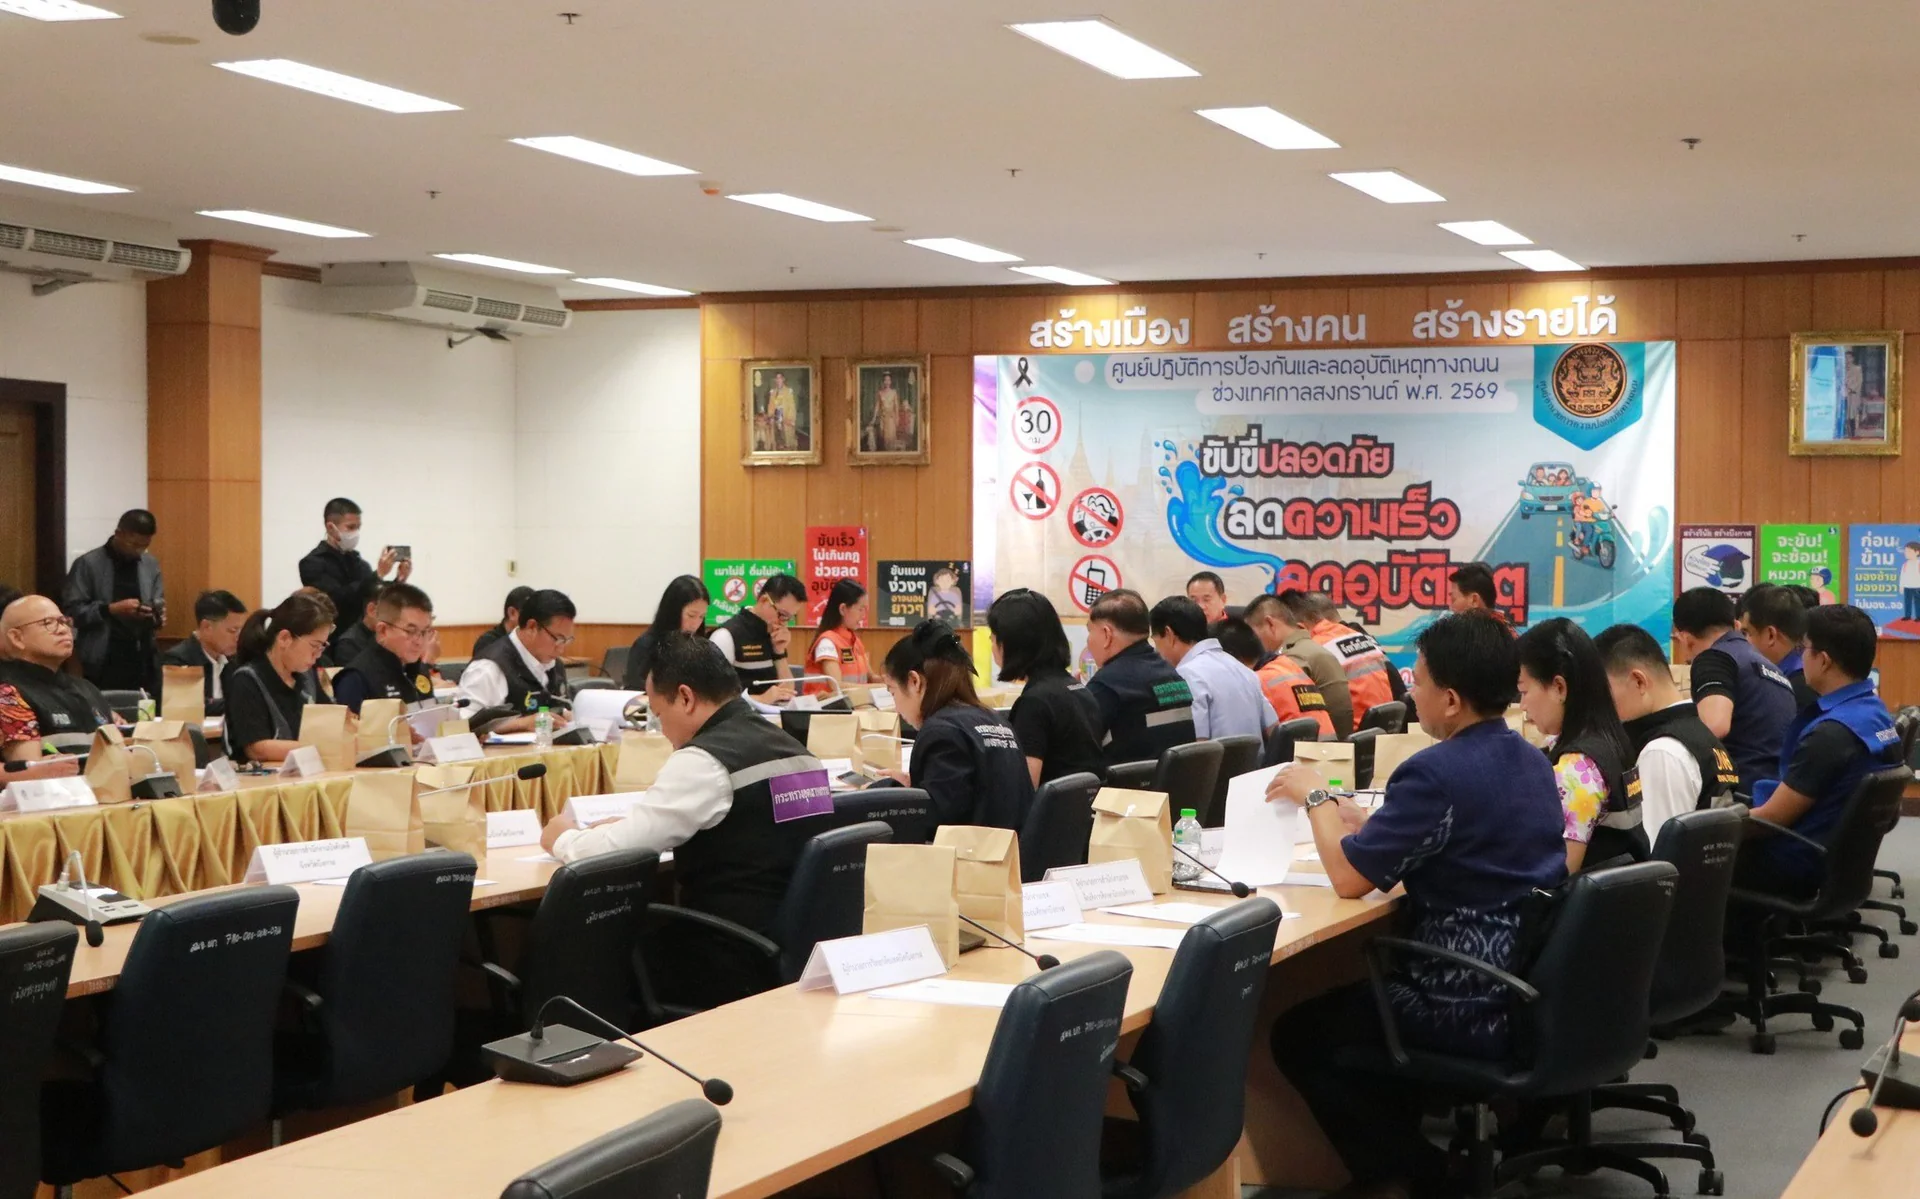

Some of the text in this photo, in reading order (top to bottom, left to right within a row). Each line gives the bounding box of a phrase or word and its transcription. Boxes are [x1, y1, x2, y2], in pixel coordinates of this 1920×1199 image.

[1029, 295, 1617, 348] สร้างเมือง สร้างคน สร้างรายได้
[1112, 353, 1499, 384] ศูนย์ปฏิบัติการป้องกันและลดอุบัติเหตุทางถนน
[1212, 379, 1499, 402] ช่วงเทศกาลสงกรานต์ พ.ศ. 2569
[1020, 409, 1051, 434] 30
[1201, 425, 1393, 477] ขับขี่ปลอดภัย
[1226, 484, 1459, 539] ลดความเร็ว
[818, 532, 856, 547] ขับเร็ว
[1777, 532, 1822, 547] จะขับ!
[1861, 548, 1894, 565] ข้าม
[815, 562, 859, 577] ช่วยลด
[890, 564, 926, 576] ขับแบบ
[1768, 570, 1807, 581] หมวก
[888, 575, 927, 597] ง่วงๆ
[1277, 551, 1528, 624] ลดอุบัติตุ
[891, 603, 924, 618] ยาวๆ
